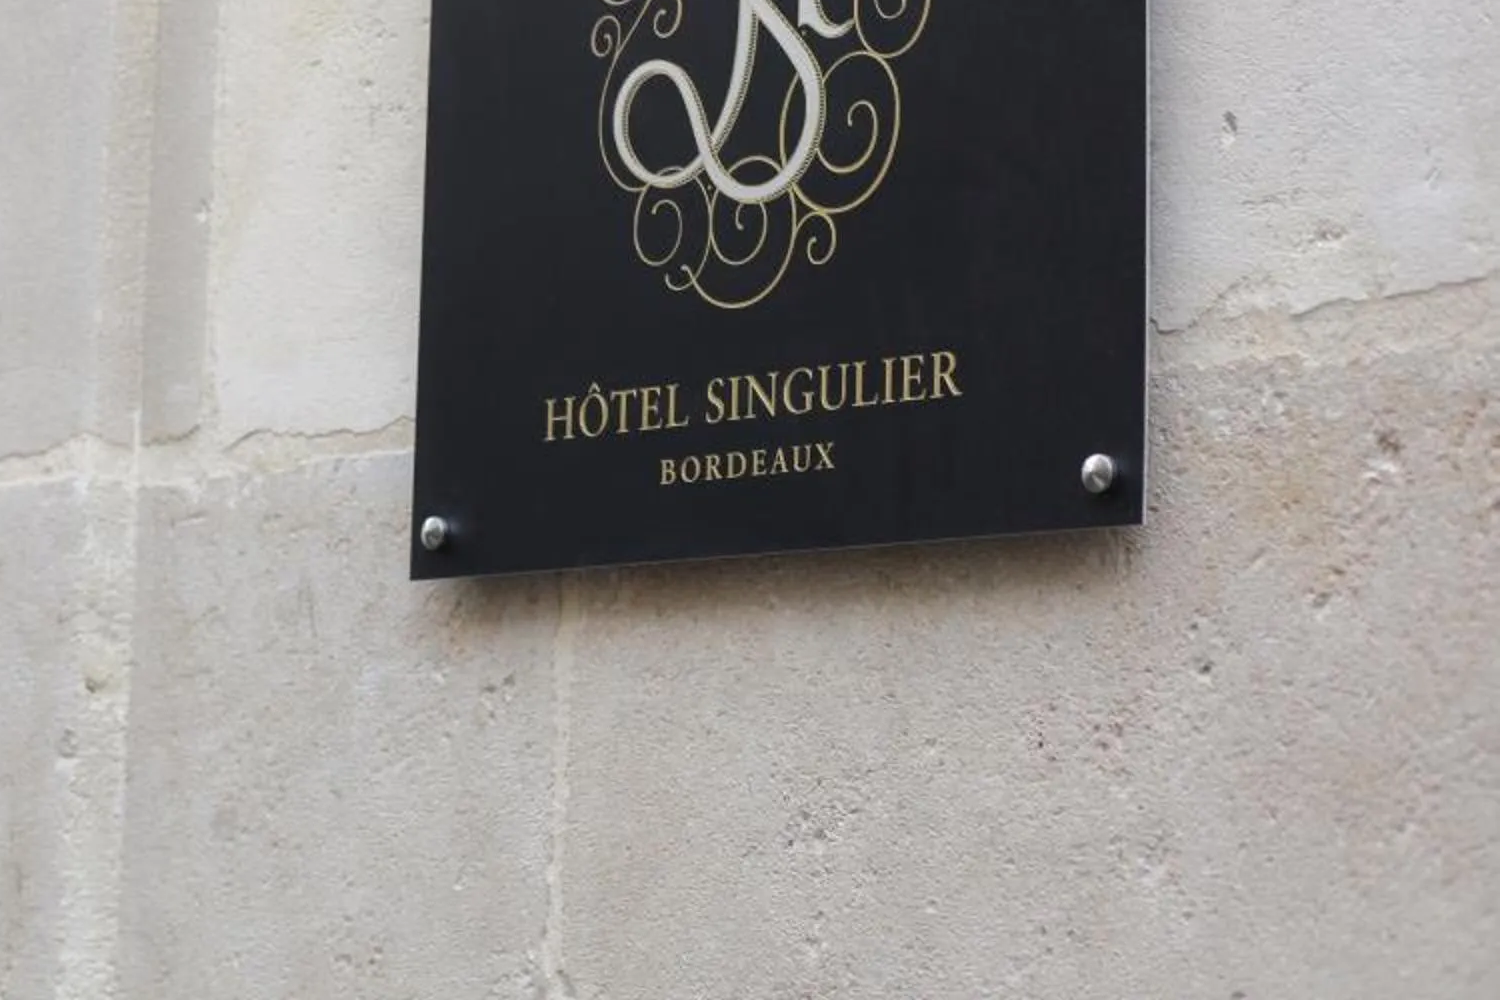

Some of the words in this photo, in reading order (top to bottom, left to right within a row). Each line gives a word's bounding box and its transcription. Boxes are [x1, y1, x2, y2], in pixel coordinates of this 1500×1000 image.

[543, 382, 690, 442] HÔTEL
[705, 351, 964, 424] SINGULIER
[660, 442, 836, 485] BORDEAUX
